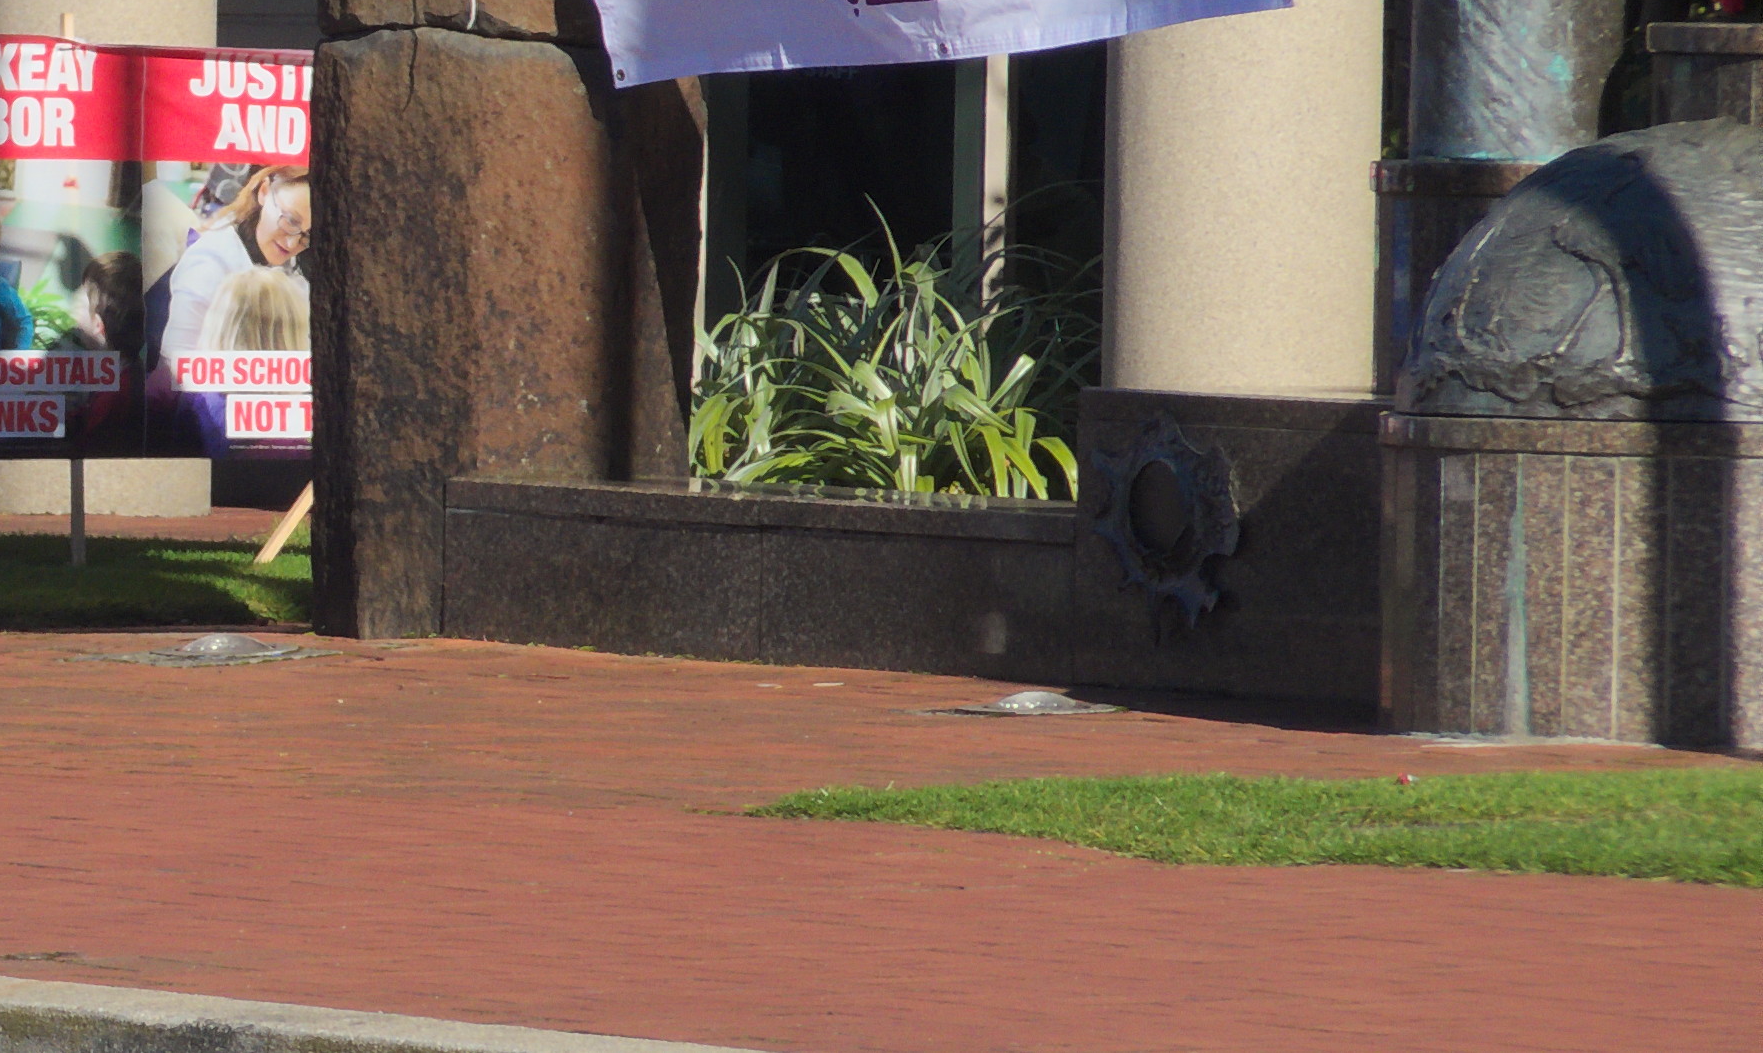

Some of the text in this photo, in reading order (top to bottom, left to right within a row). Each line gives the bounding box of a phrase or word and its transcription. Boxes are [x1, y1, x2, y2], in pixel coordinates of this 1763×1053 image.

[189, 53, 313, 102] JUSTI
[213, 103, 307, 155] AND
[176, 357, 313, 385] FOR SCHOO
[234, 400, 292, 432] NOT
